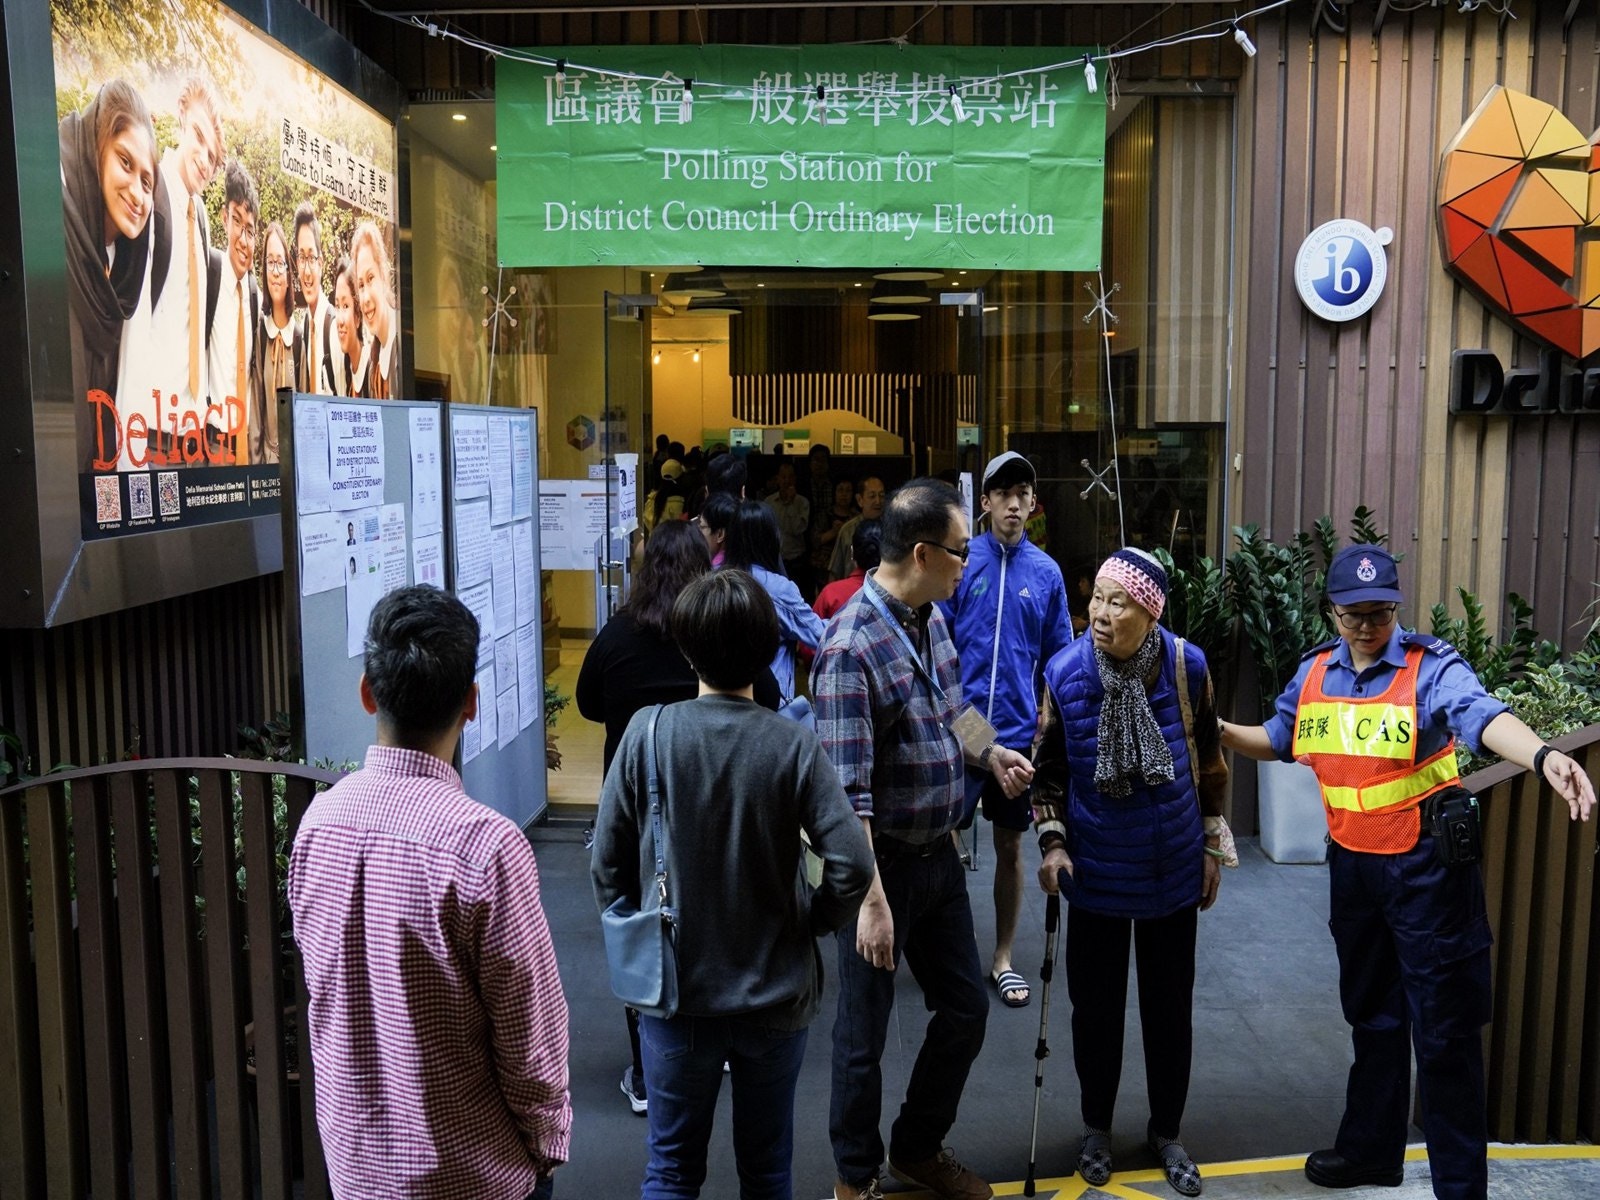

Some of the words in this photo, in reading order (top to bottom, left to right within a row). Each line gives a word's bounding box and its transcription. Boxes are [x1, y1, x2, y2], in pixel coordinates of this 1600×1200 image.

[543, 71, 1059, 128] 區議會一般選舉投票站
[282, 149, 307, 178] Come
[310, 161, 319, 183] to
[321, 167, 346, 196] Learn
[347, 183, 357, 202] Go
[359, 186, 367, 206] to
[661, 149, 769, 189] Polling
[779, 149, 884, 183] Station
[894, 151, 938, 183] for
[543, 200, 653, 232] District
[662, 200, 778, 232] Council
[790, 201, 923, 241] Ordinary
[932, 202, 1056, 236] Election
[1349, 226, 1373, 245] WORLD
[1325, 243, 1361, 294] ib
[331, 411, 343, 421] 2019
[87, 389, 245, 471] DeliaGP
[338, 446, 355, 455] POLLING
[356, 445, 372, 454] STATION
[372, 445, 377, 453] OF
[336, 458, 346, 467] 2019
[346, 457, 364, 466] DISTRICT
[364, 456, 380, 465] COUNCIL
[185, 486, 196, 494] Delia
[196, 484, 213, 493] Memorial
[214, 482, 227, 491] School
[332, 480, 364, 491] CONSTITUENCY
[365, 478, 383, 487] ORDINARY
[352, 491, 369, 500] ELECTION
[1356, 718, 1410, 744] CAS
